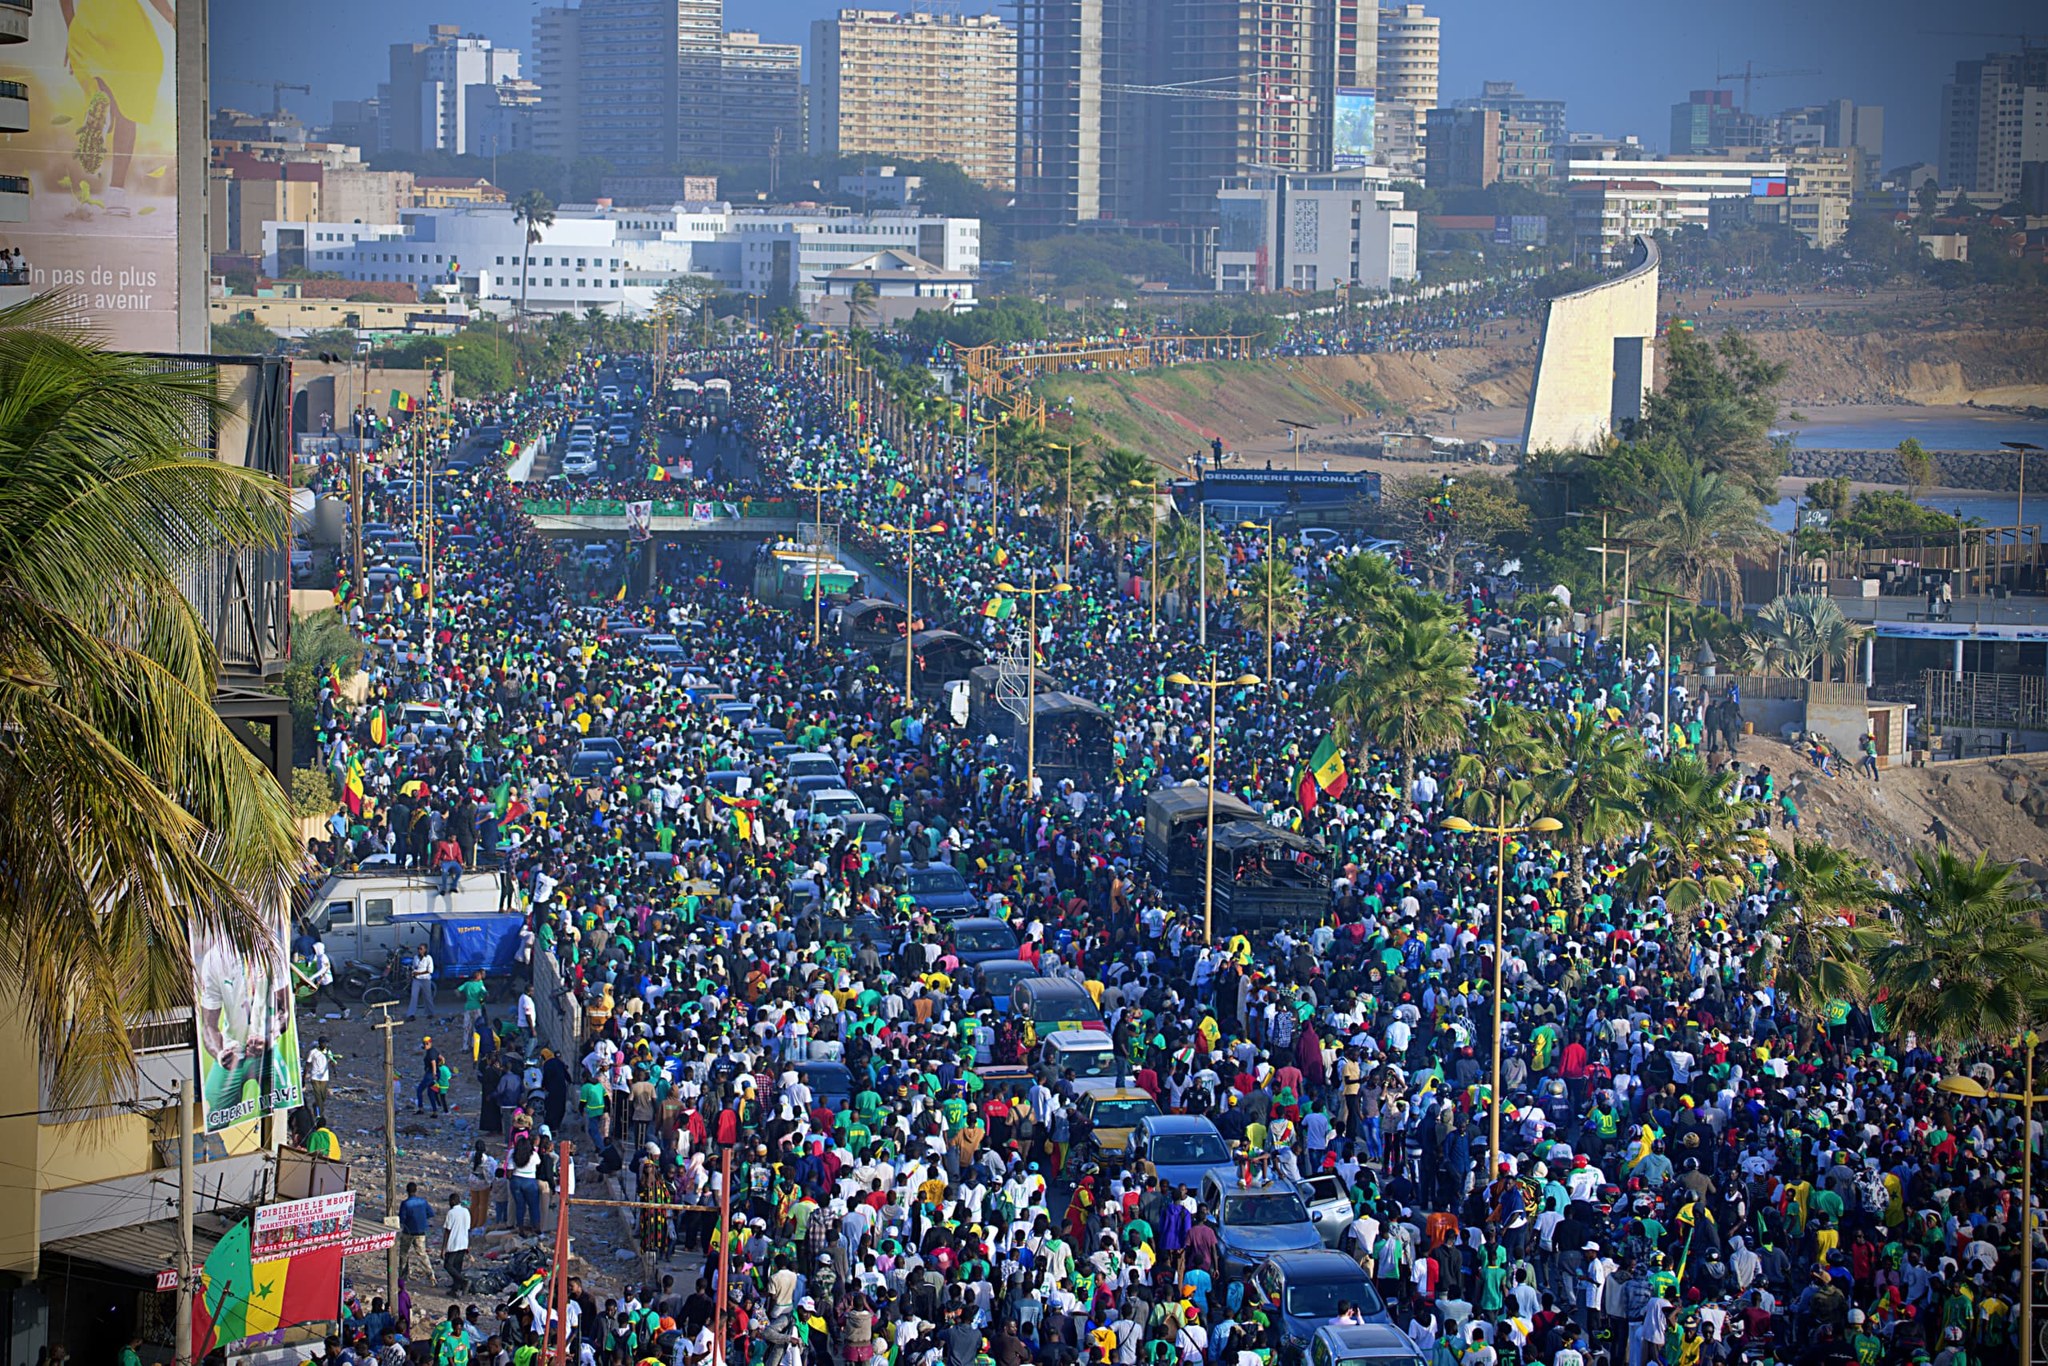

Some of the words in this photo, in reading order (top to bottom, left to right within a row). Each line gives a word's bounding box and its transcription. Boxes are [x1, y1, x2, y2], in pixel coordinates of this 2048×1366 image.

[52, 269, 85, 287] pas
[91, 265, 113, 285] de
[119, 266, 157, 290] plus
[95, 290, 152, 310] avenir
[1294, 475, 1361, 483] NATIONALE
[210, 1100, 255, 1125] CHERIF
[950, 1110, 961, 1123] 37
[1601, 1115, 1612, 1128] 10
[262, 1200, 310, 1217] DIBITERIE
[313, 1199, 323, 1209] LE
[278, 1211, 301, 1221] DAROU
[301, 1208, 323, 1219] SALAM
